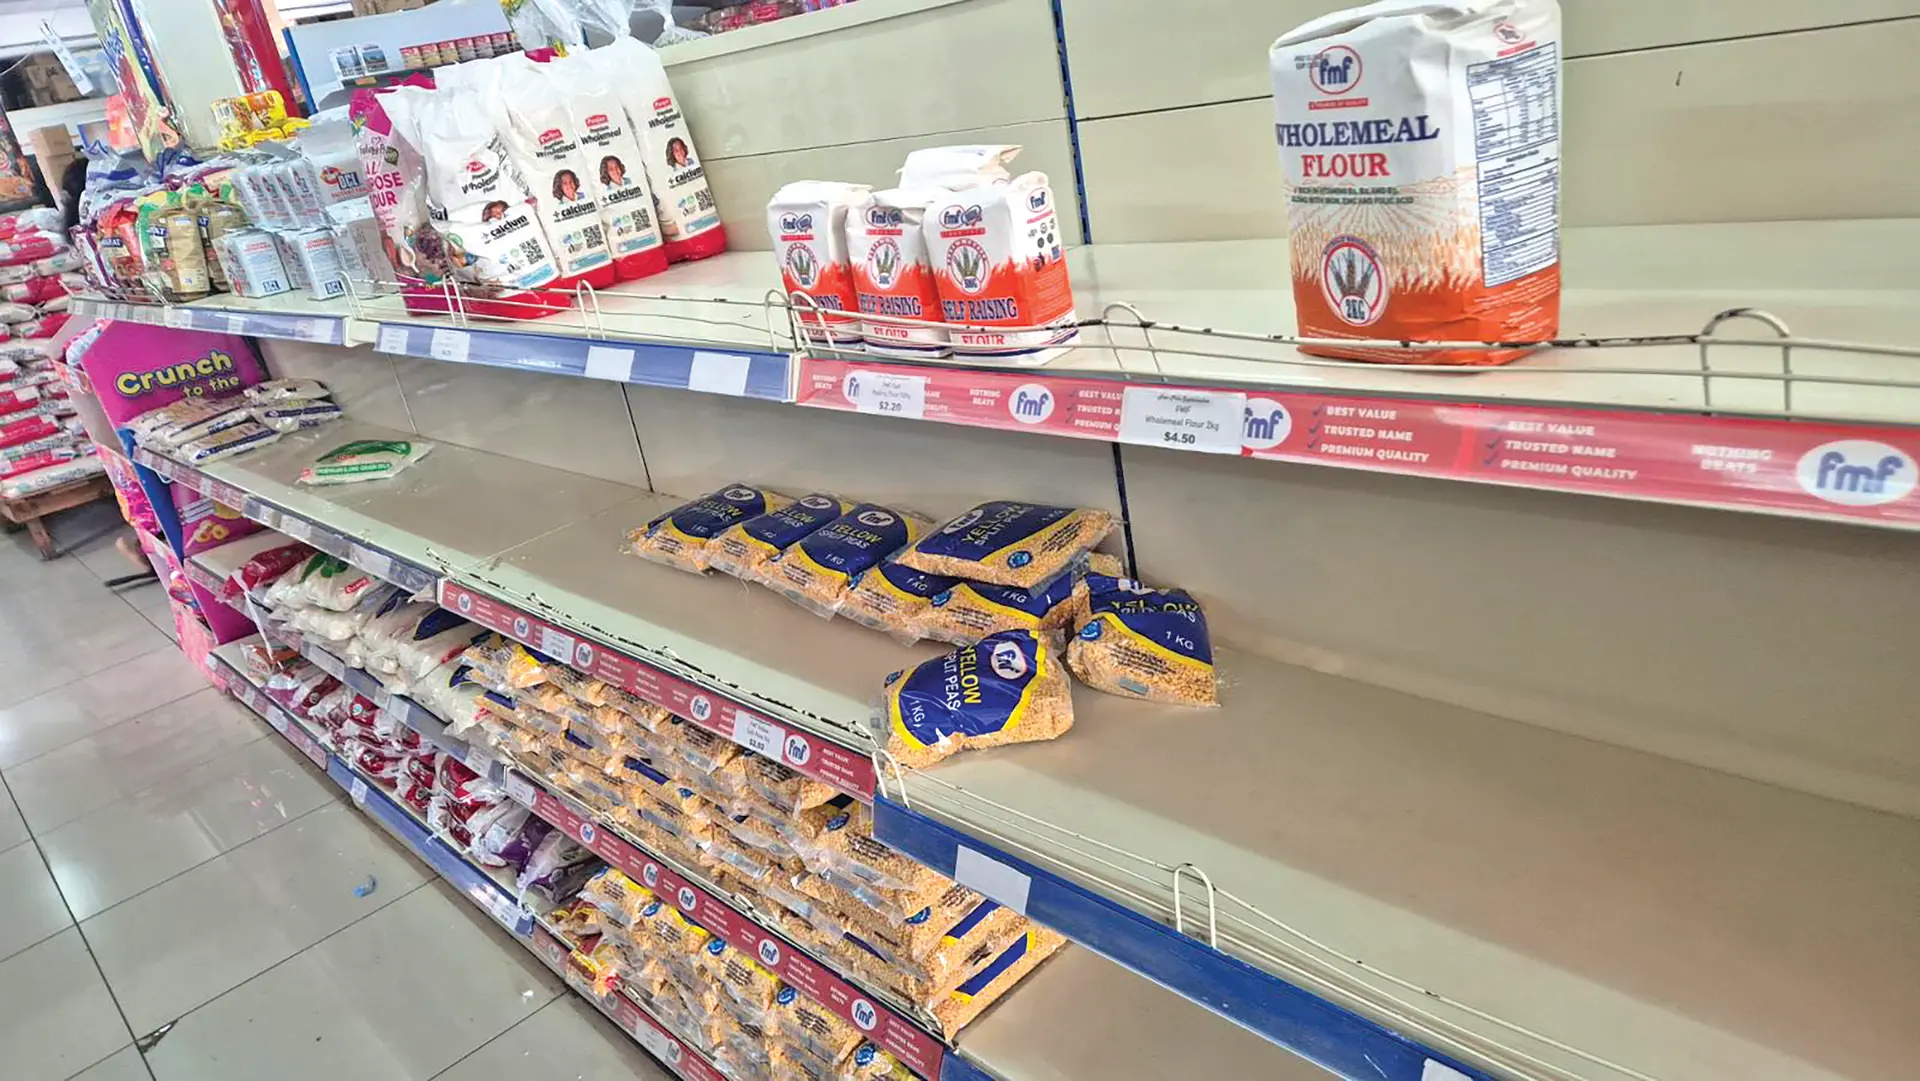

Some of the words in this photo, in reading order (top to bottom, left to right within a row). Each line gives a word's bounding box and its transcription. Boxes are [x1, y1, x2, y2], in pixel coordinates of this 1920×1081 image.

[1319, 56, 1353, 86] fmf
[1275, 115, 1441, 148] WHOLEMEAL
[675, 166, 704, 183] calcium
[1301, 152, 1390, 178] FLOUR
[608, 186, 643, 201] calcium
[1030, 192, 1046, 209] fmf
[561, 200, 596, 217] calcium
[944, 210, 961, 224] fmf
[490, 214, 528, 238] calcium
[879, 295, 922, 316] RAISING
[943, 300, 964, 320] SELF
[968, 298, 1017, 321] RAISING
[116, 349, 234, 397] Crunch
[183, 386, 204, 399] to
[209, 376, 240, 392] the
[969, 387, 1001, 398] NOTHING
[1078, 389, 1099, 400] BEST
[1100, 391, 1123, 401] VALU
[879, 401, 902, 412] $2.20
[1016, 391, 1049, 417] fmf
[1077, 404, 1113, 416] TRUSTED
[1326, 406, 1356, 417] BEST
[1358, 407, 1398, 420] VALUE
[1074, 418, 1112, 431] PREMIUM
[1145, 414, 1183, 428] Wholemeal
[1185, 417, 1205, 429] Flour
[1508, 421, 1544, 433] BEST
[1547, 423, 1596, 437] VALUE
[1163, 431, 1196, 445] $4.50
[1324, 425, 1376, 438] TRUSTED
[1377, 429, 1414, 442] NAME
[1320, 443, 1374, 457] PREMIUM
[1376, 448, 1430, 463] QUALITY
[1504, 440, 1569, 455] TRUSTED
[1572, 445, 1617, 459] NAME
[1692, 445, 1773, 461] NOTHING
[1501, 458, 1569, 474] PREMIUM
[1571, 465, 1638, 480] QUALITY
[1816, 451, 1904, 494] fmf
[832, 523, 883, 543] YELLOW
[961, 504, 1022, 545] YELLOW
[830, 555, 845, 565] KG
[913, 580, 928, 592] KG
[1000, 590, 1008, 599] 1
[1008, 592, 1028, 604] KG
[1165, 630, 1173, 640] 1
[1175, 635, 1195, 651] KG
[960, 642, 983, 705] YELLOW
[944, 674, 962, 712] PEAS
[911, 705, 926, 721] KG
[788, 738, 808, 761] fmf
[760, 943, 778, 963] fmf
[854, 1003, 875, 1026] fmf
